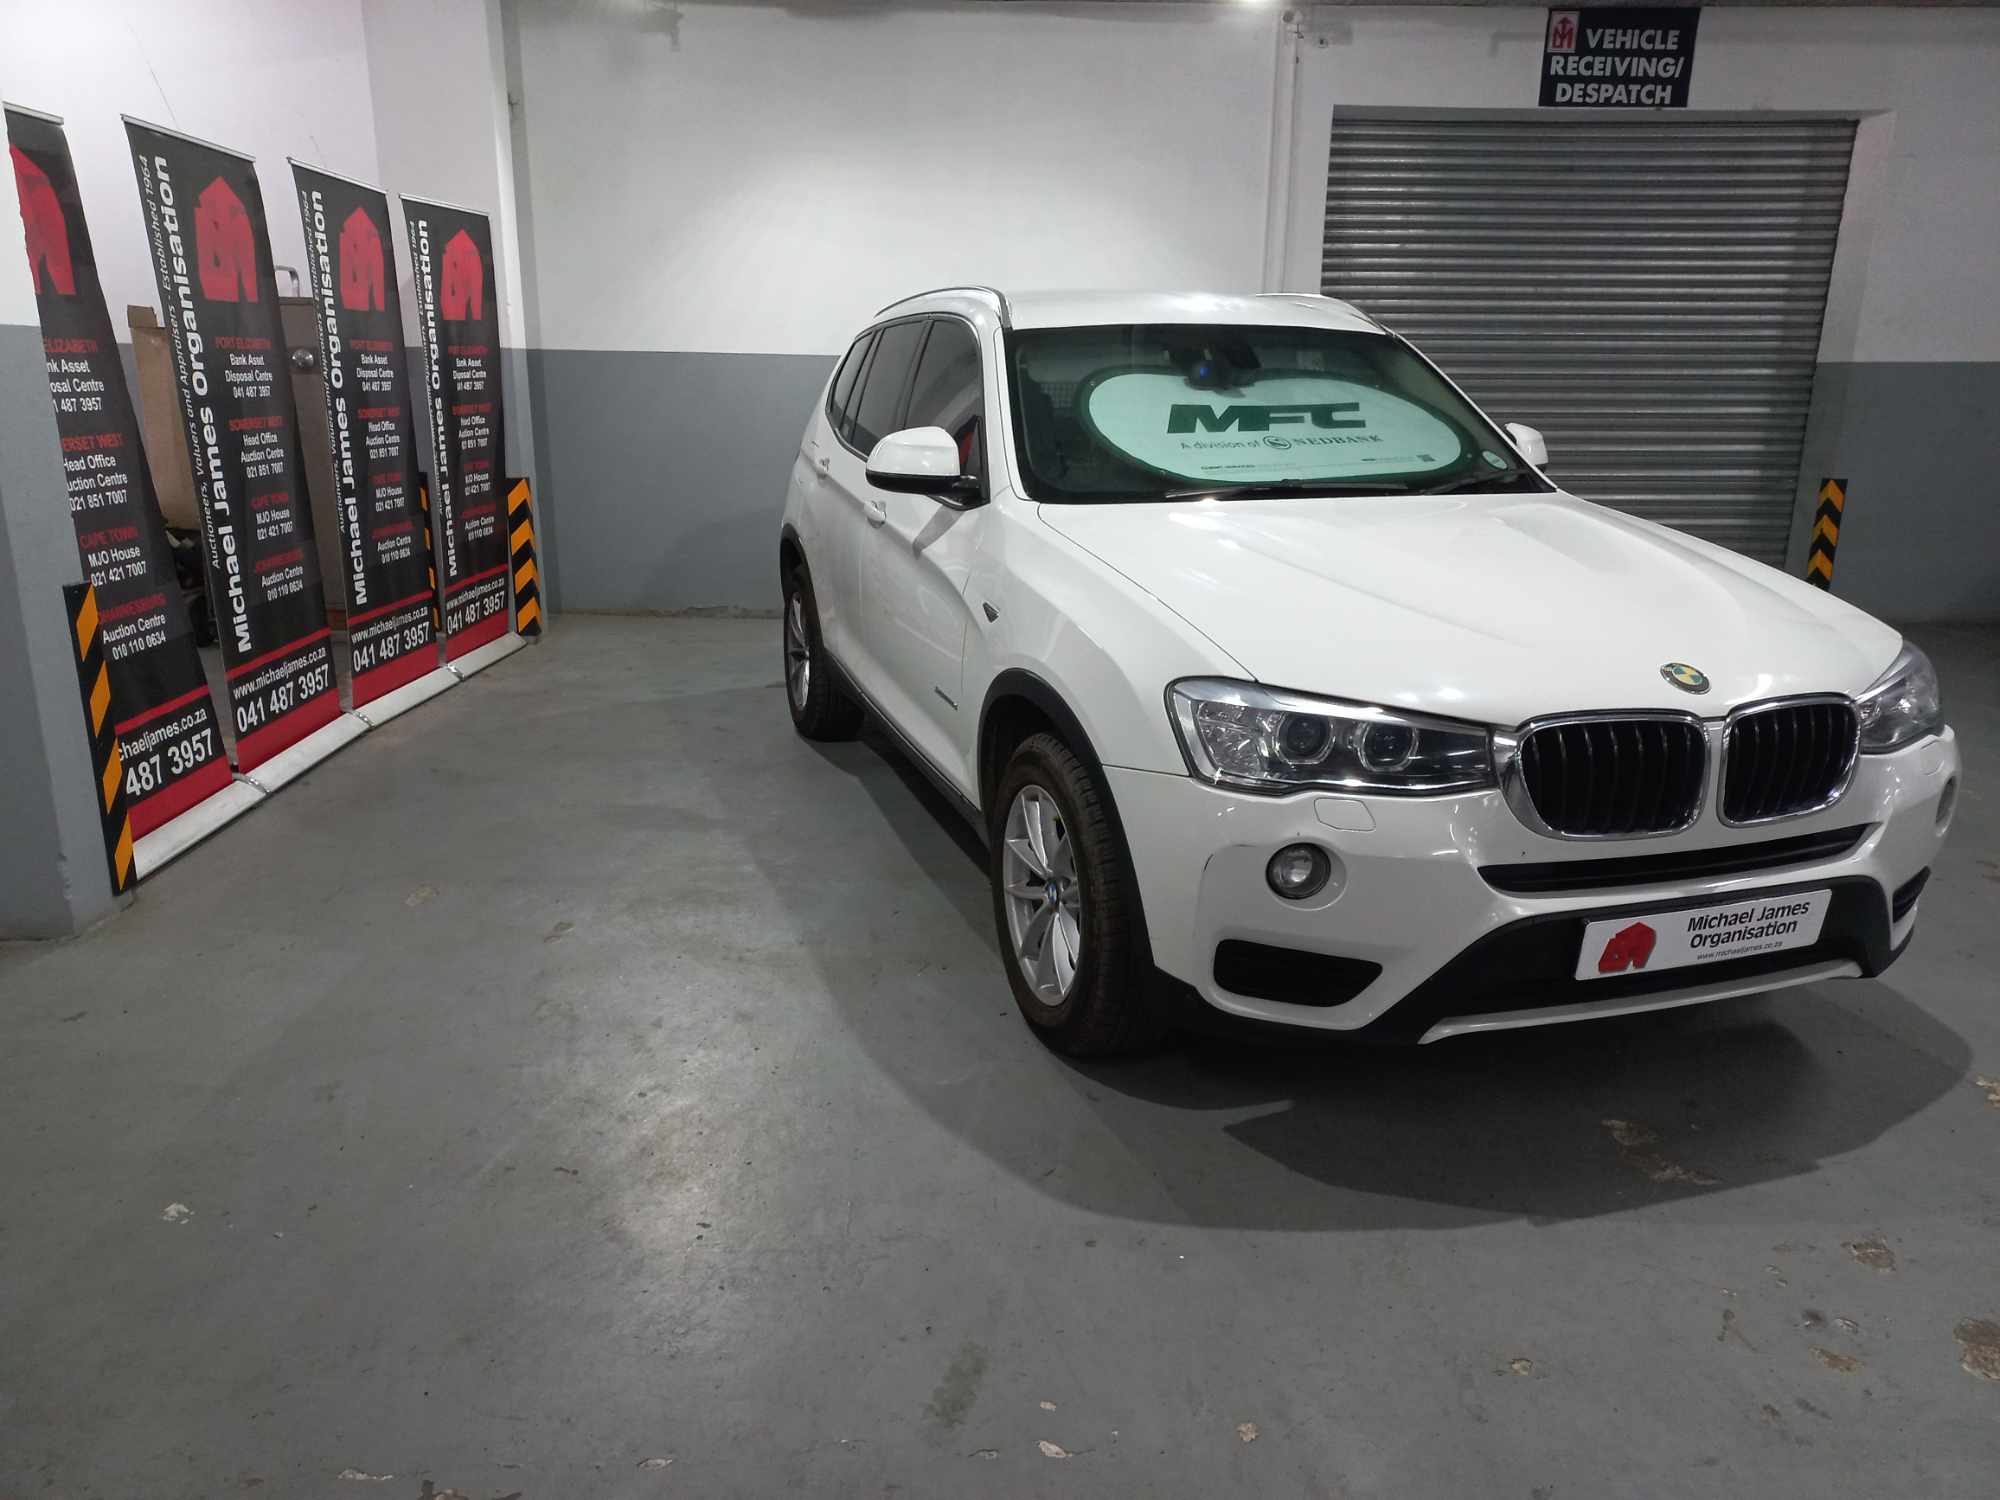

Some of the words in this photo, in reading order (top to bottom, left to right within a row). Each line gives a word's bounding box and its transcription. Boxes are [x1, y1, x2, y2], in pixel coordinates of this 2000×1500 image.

[1585, 28, 1681, 50] VEHICLE
[1550, 55, 1685, 78] RECEIVING/
[1555, 82, 1673, 105] DESPATCH
[47, 358, 60, 373] nk
[61, 358, 91, 373] Asset
[229, 353, 247, 366] Bank
[50, 379, 72, 393] osal
[73, 378, 105, 392] Centre
[61, 398, 77, 412] 487
[80, 397, 102, 412] 3957
[181, 388, 195, 418] and
[1167, 402, 1366, 433] MFC
[336, 397, 354, 489] James
[434, 397, 449, 477] James
[1292, 434, 1384, 447] NEDBANK
[87, 454, 117, 469] Office
[200, 407, 230, 516] James
[241, 450, 264, 463] Auction
[67, 477, 96, 491] uction
[97, 472, 128, 487] Centre
[69, 496, 86, 511] 021
[87, 493, 104, 508] 851
[105, 489, 128, 505] 7007
[271, 509, 290, 521] House
[442, 484, 457, 576] Michael
[88, 550, 109, 567] MJO
[111, 546, 141, 562] House
[345, 497, 367, 605] Michael
[90, 571, 107, 587] 021
[109, 566, 125, 582] 421
[126, 561, 147, 577] 7007
[218, 525, 252, 653] Michael
[447, 610, 463, 634] 041
[465, 601, 480, 624] 487
[483, 591, 505, 616] 3957
[103, 624, 136, 644] Auction
[138, 614, 166, 632] Centre
[112, 643, 127, 660] 010
[129, 638, 145, 654] 110
[353, 643, 375, 672] 041
[380, 633, 400, 660] 487
[403, 621, 429, 650] 3957
[237, 697, 265, 732] 041
[270, 681, 293, 714] 487
[298, 663, 328, 699] 3957
[118, 708, 207, 761] chaeljames.co.za
[126, 754, 162, 796] 487
[168, 727, 212, 774] 3957
[1688, 908, 1755, 932] Michael
[1757, 901, 1810, 922] James
[1690, 920, 1797, 948] Organisation
